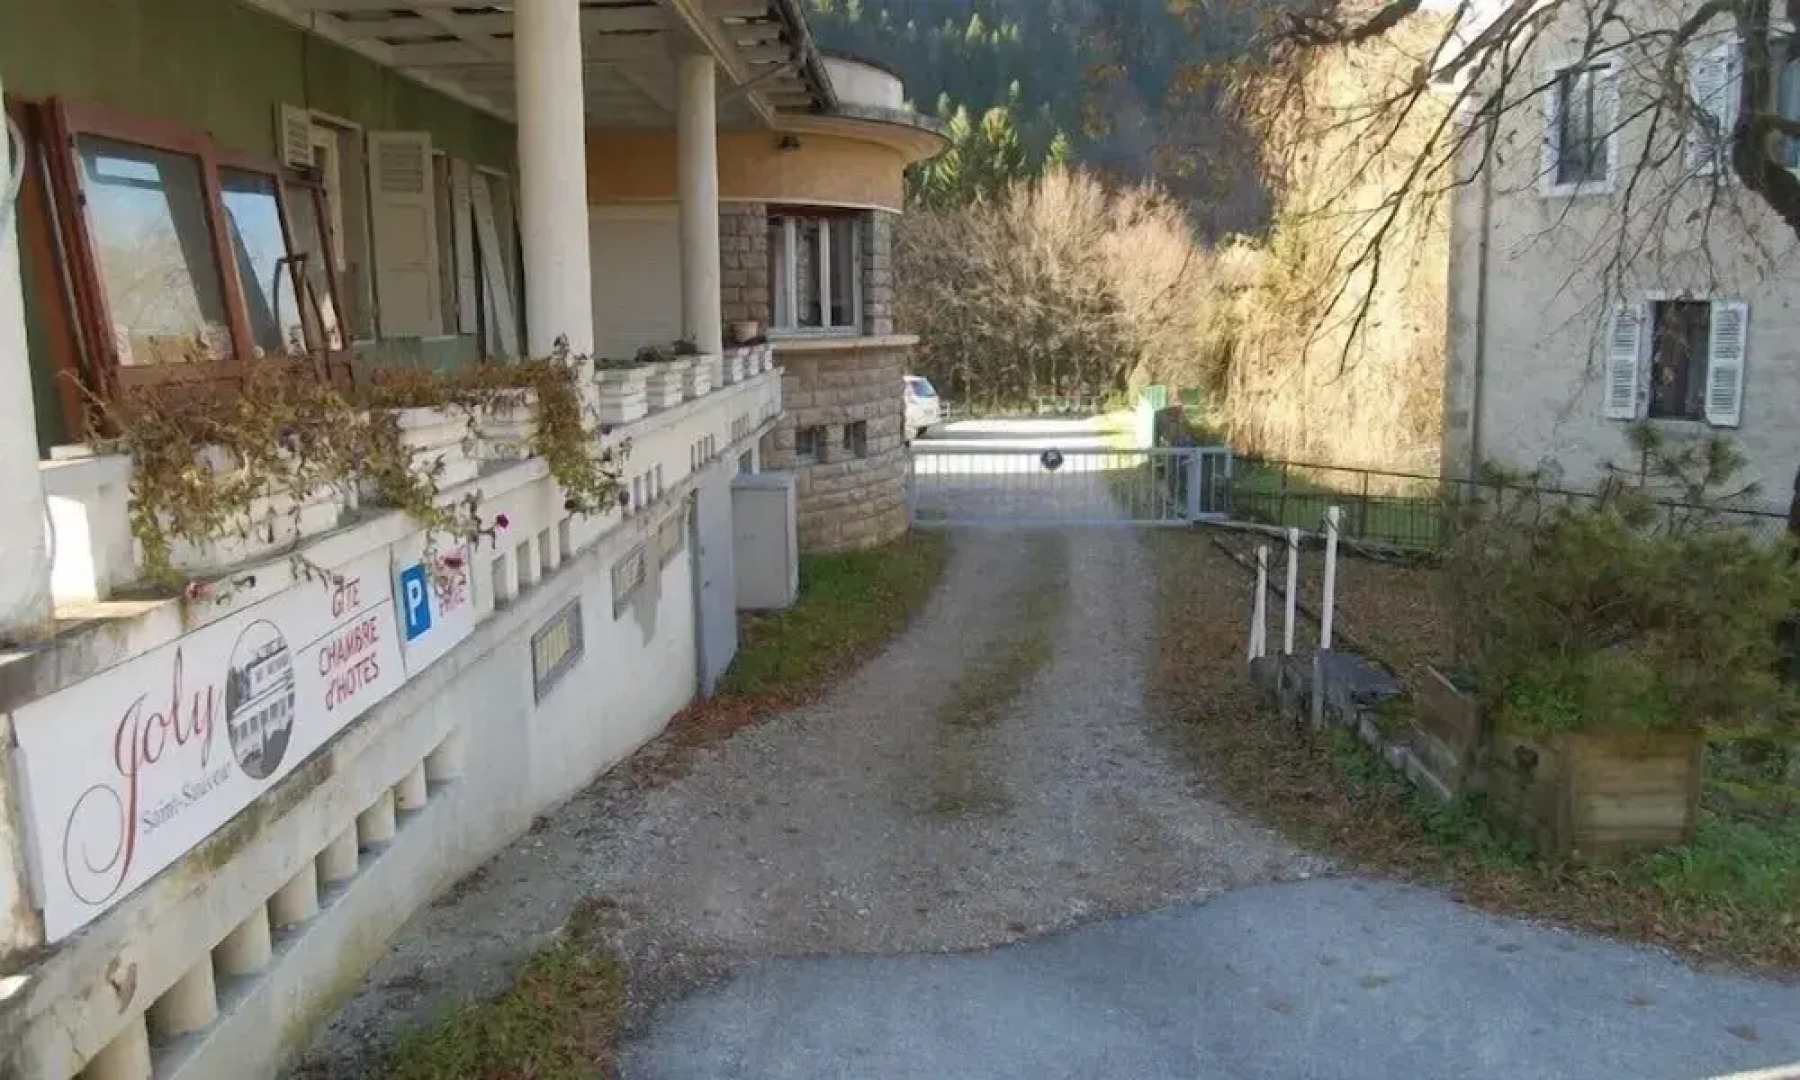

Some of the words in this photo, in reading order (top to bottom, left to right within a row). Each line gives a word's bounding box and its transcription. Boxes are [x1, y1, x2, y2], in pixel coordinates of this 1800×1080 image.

[406, 578, 422, 627] P
[318, 616, 379, 677] CHAMBRE
[63, 646, 223, 906] Joly
